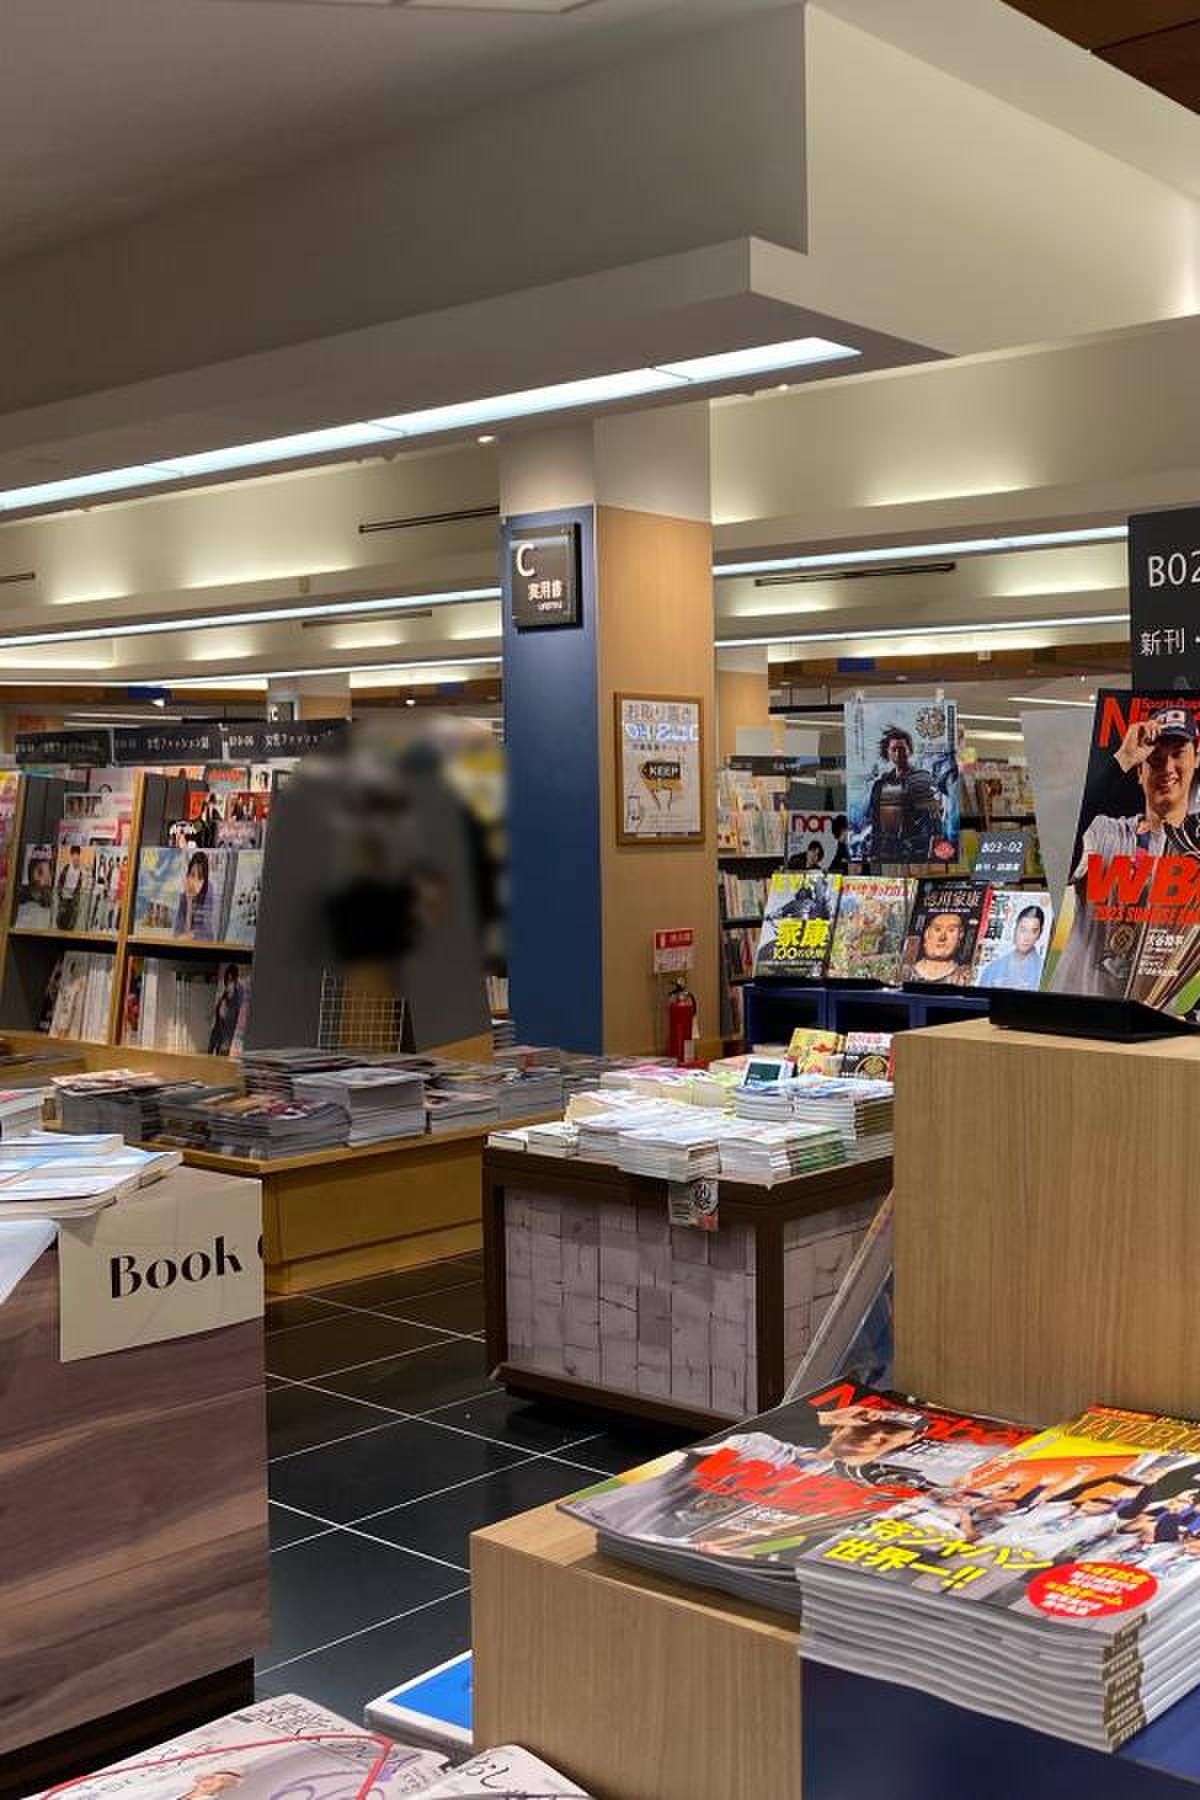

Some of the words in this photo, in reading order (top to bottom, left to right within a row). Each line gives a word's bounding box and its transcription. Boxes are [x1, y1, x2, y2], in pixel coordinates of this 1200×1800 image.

[516, 543, 535, 577] C
[775, 917, 831, 948] 家康
[111, 1236, 242, 1298] Book
[868, 1518, 1055, 1571] 侍ジャパン
